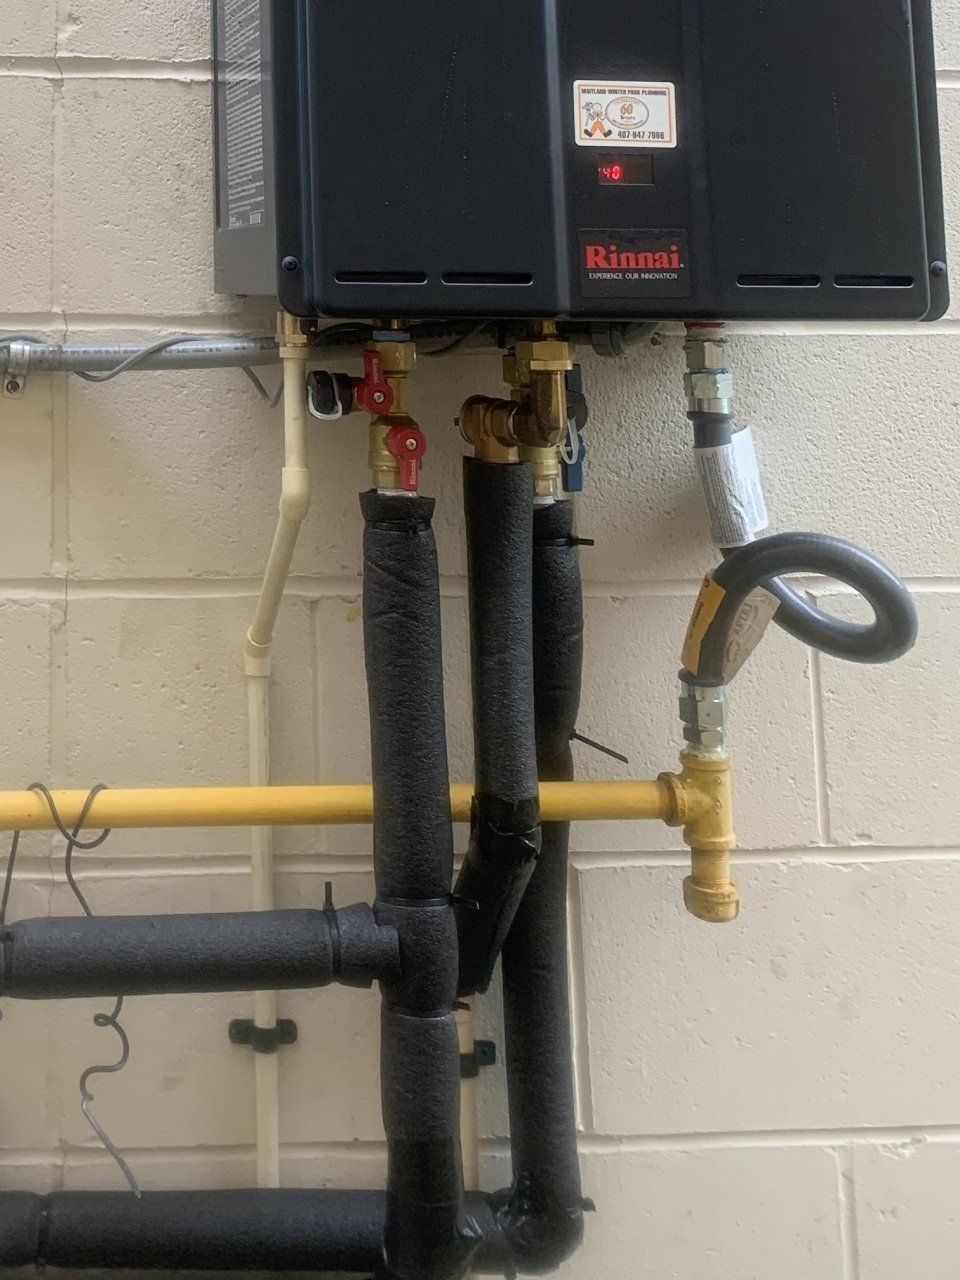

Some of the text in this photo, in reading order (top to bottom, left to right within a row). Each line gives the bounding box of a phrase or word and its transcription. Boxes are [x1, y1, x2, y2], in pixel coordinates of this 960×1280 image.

[620, 103, 634, 115] 60
[585, 245, 680, 269] Rinnai
[588, 272, 678, 280] EXPERIENCE OUR INNOVATION
